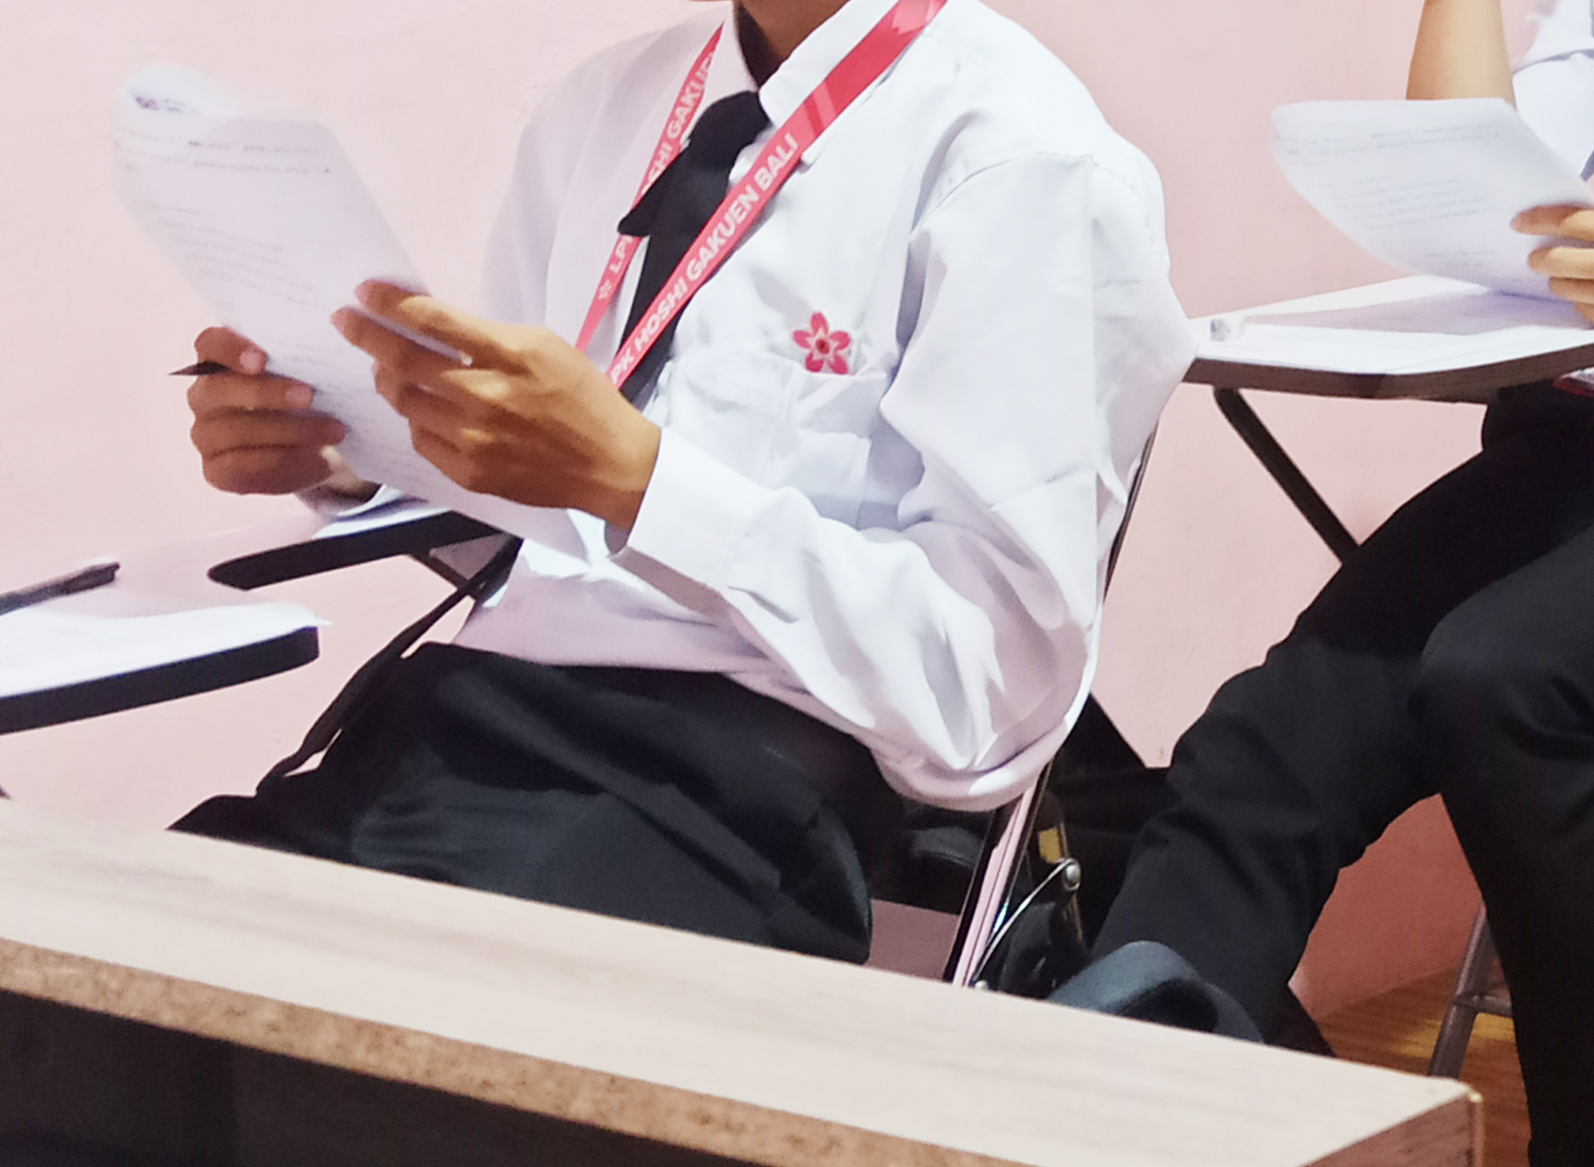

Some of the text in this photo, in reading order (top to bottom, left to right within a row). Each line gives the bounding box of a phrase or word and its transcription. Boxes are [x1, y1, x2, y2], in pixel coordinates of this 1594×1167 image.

[609, 132, 799, 385] PK HOSHI GAKUEN BALI
